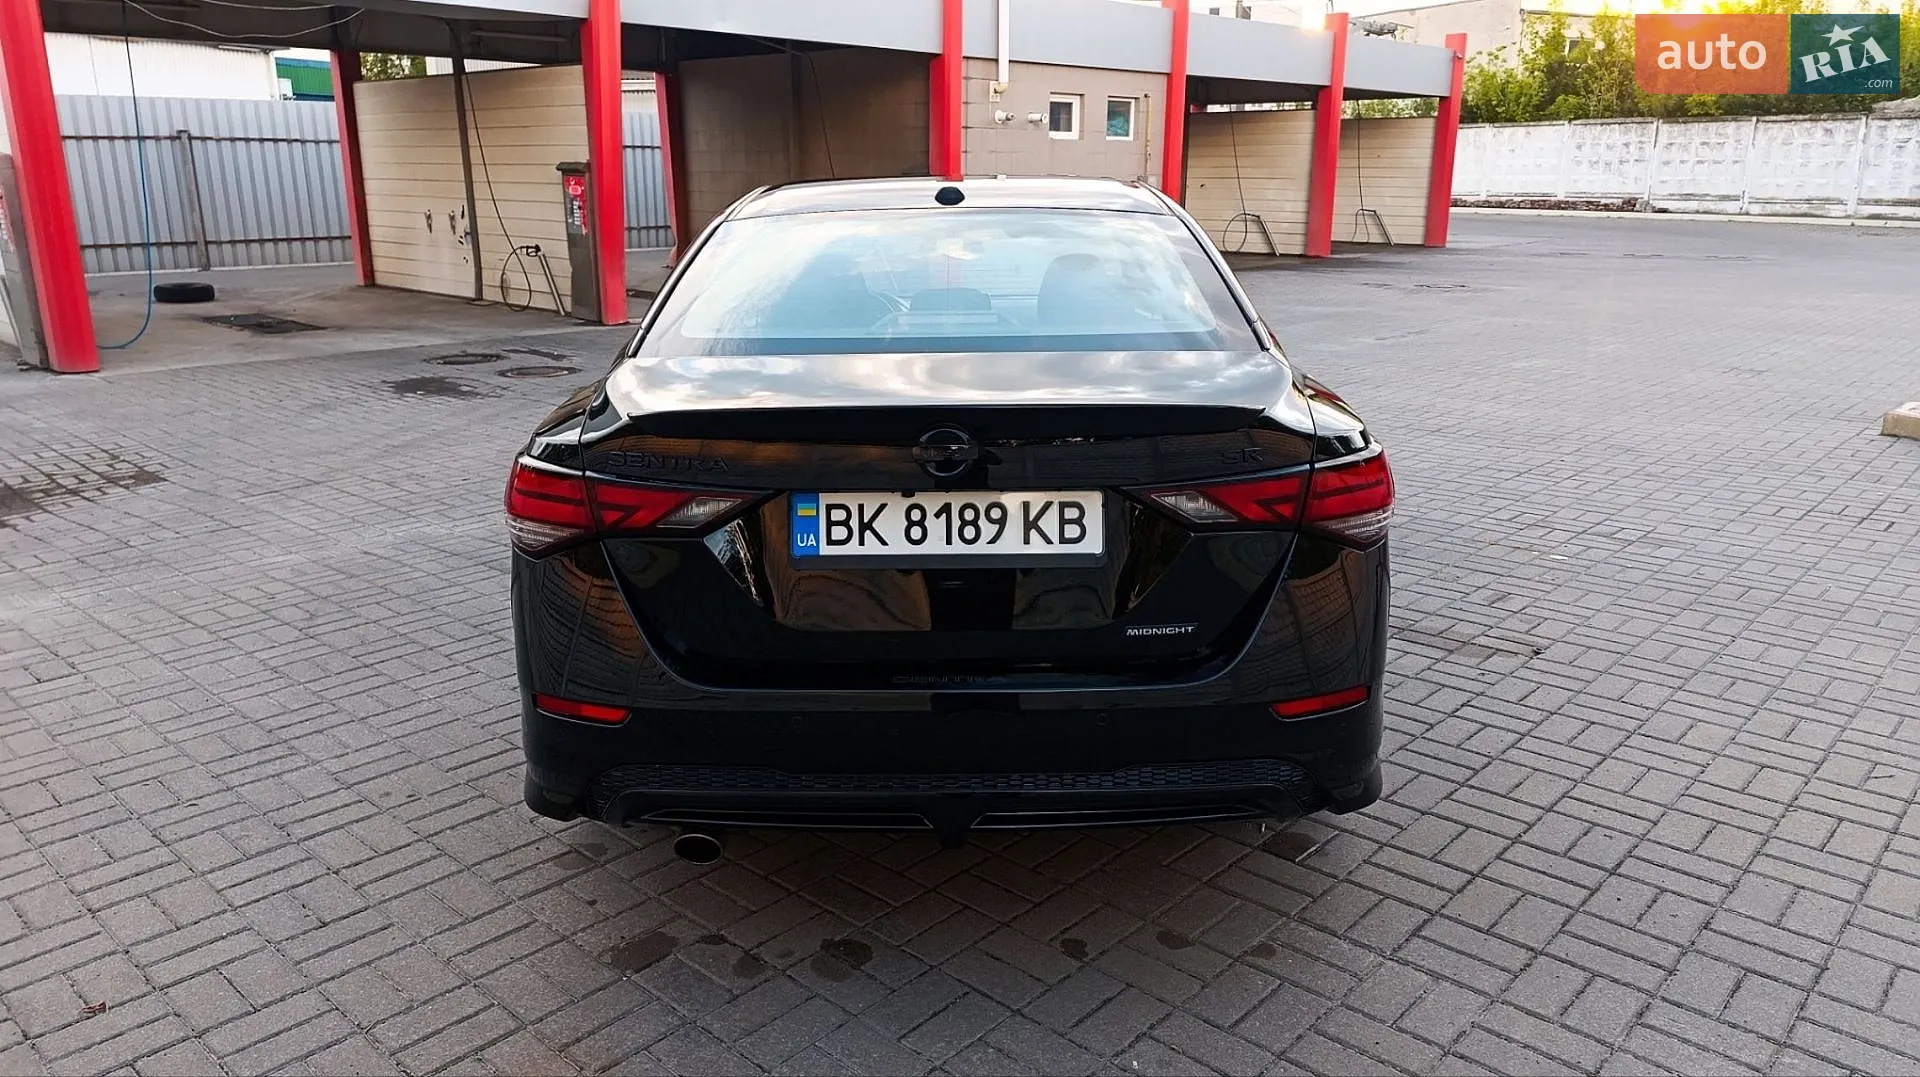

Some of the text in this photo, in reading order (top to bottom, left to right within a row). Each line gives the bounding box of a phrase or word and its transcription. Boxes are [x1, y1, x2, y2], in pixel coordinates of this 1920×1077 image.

[824, 500, 1087, 547] BK 8189 KB
[797, 533, 817, 547] UA
[1126, 626, 1195, 636] MIDNIGHT
